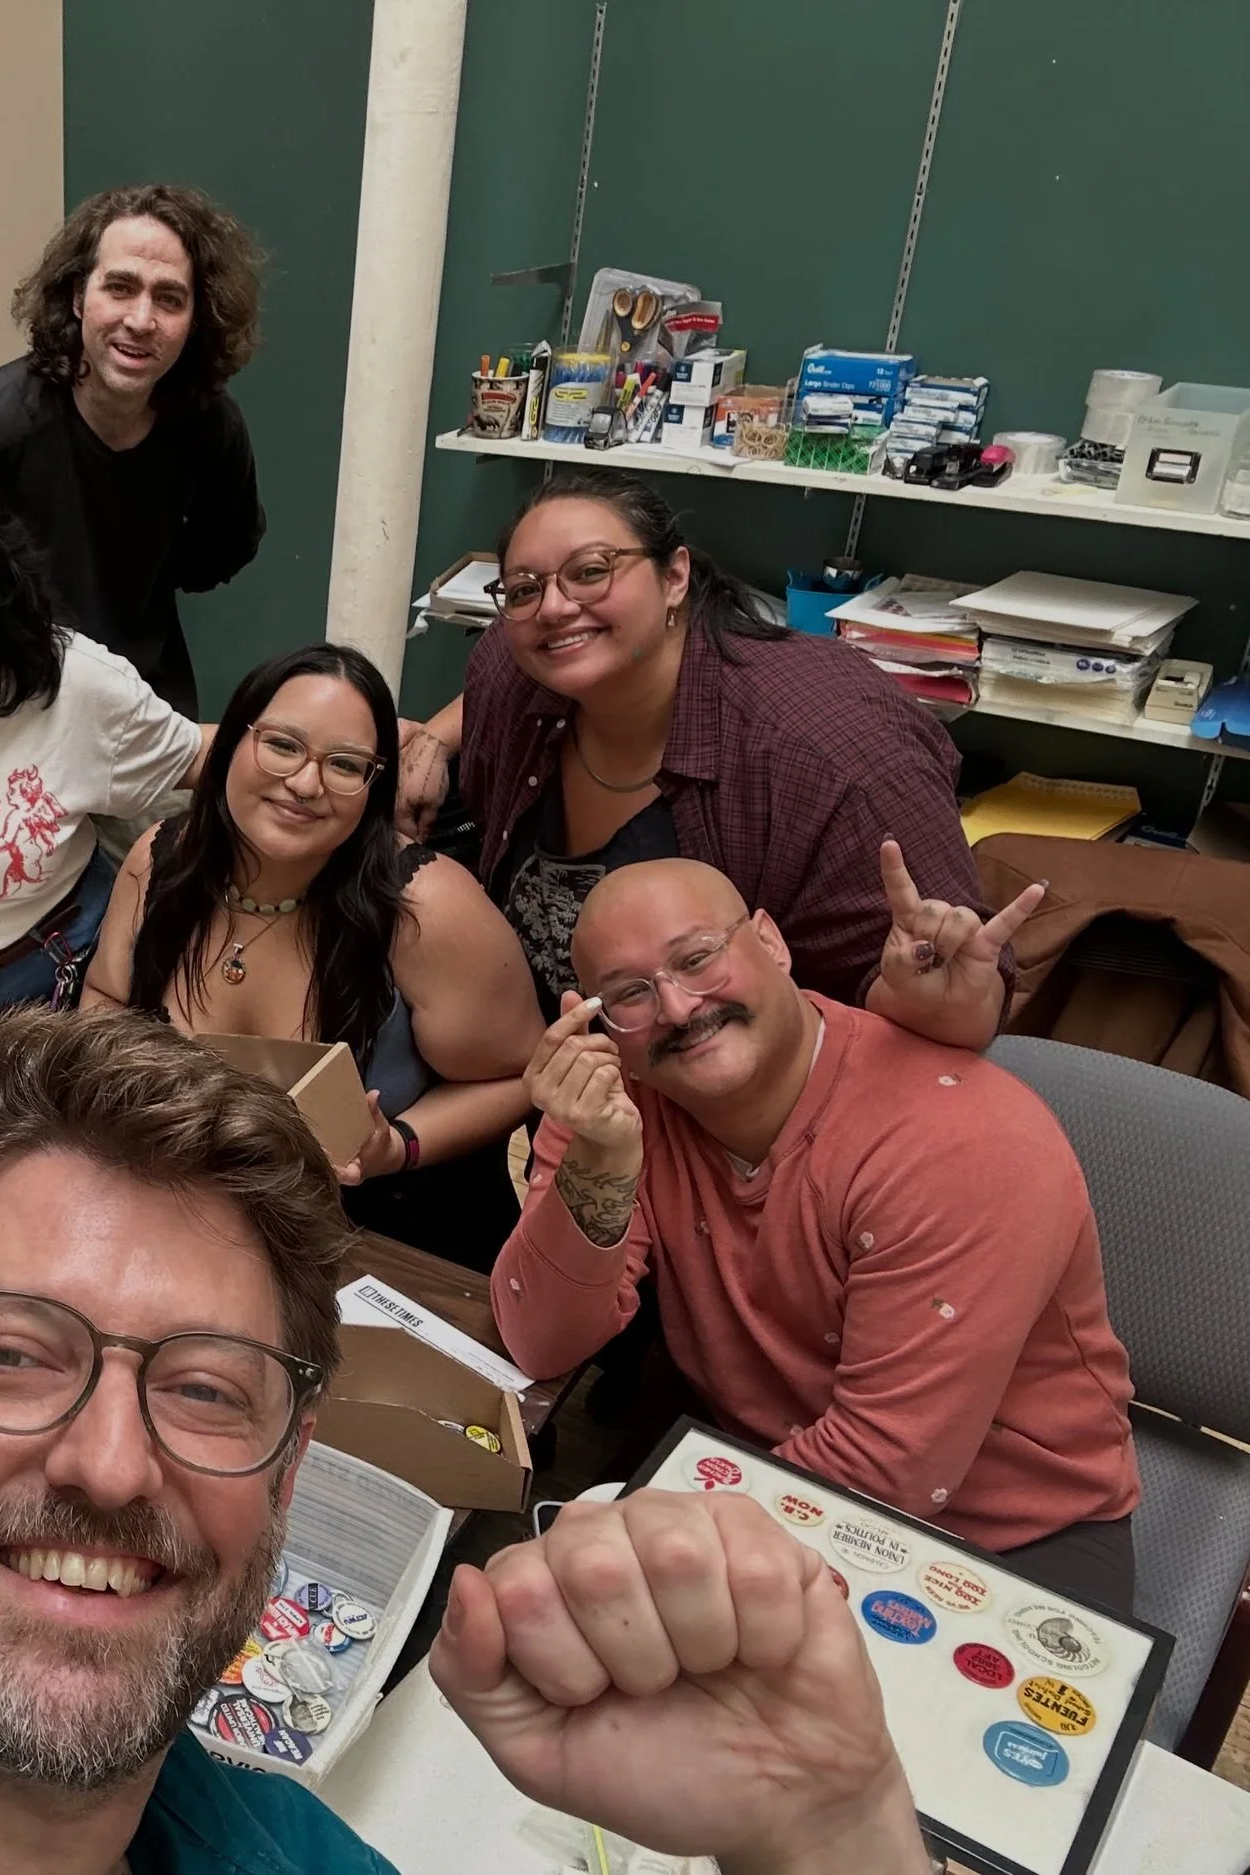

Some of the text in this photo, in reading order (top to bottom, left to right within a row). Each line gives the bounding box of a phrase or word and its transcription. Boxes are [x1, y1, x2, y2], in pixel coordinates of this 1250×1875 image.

[805, 380, 822, 388] Large
[781, 1494, 823, 1517] NOW
[833, 1530, 906, 1565] UNION MEMBER
[845, 1524, 900, 1551] IN POLITICS
[924, 1574, 982, 1606] TOO NICE
[929, 1565, 987, 1597] TOO LONG
[964, 1658, 1002, 1681] LOCAL
[219, 1703, 238, 1728] UNITED
[1023, 1687, 1089, 1727] FUENTES
[232, 1700, 261, 1748] UNIVERSAL
[277, 1729, 304, 1760] REAGAN
